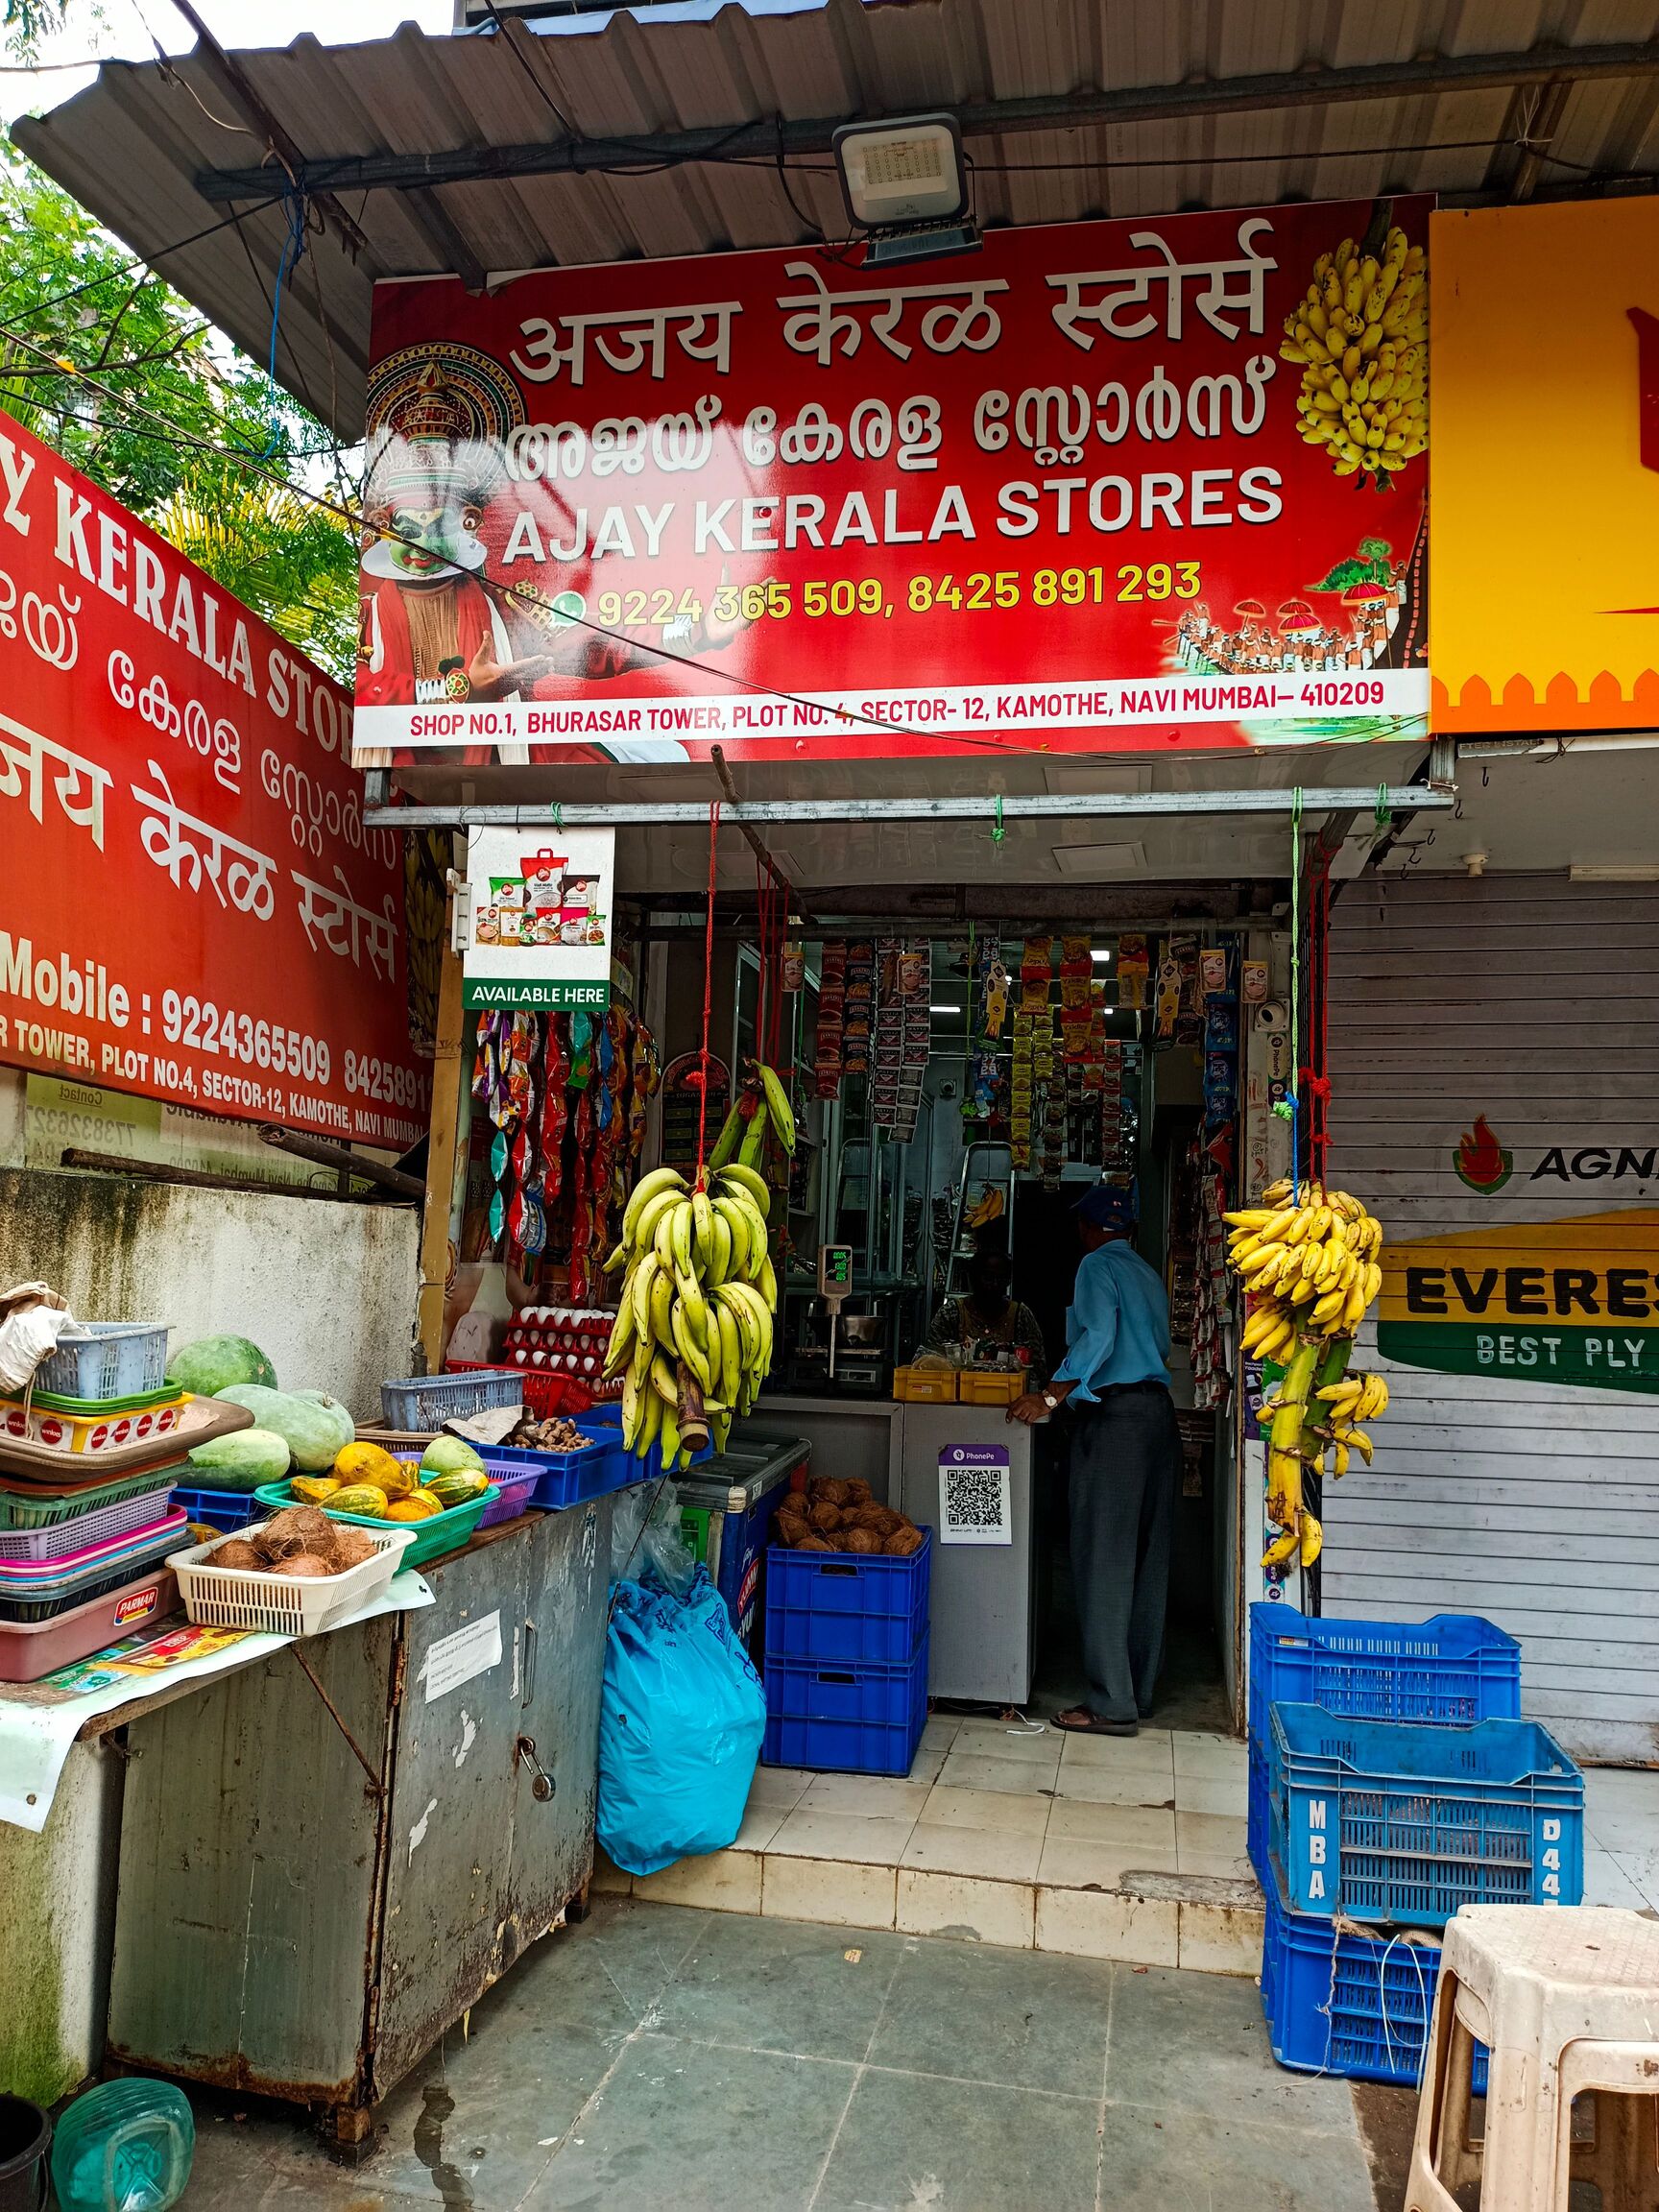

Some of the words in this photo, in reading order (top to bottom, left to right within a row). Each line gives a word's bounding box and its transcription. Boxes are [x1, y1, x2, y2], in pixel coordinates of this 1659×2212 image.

[510, 301, 743, 386] अजय
[776, 261, 1009, 366] केरळ
[1046, 218, 1278, 350] स्टोर्स
[506, 395, 722, 482] അജയ്
[742, 395, 943, 470] കേരള
[502, 502, 675, 565] AJAY
[695, 485, 976, 555] KERALA
[996, 466, 1284, 538] STORES
[54, 476, 257, 699] KERALA
[598, 588, 703, 627] 9224
[714, 583, 792, 622] 365
[804, 578, 894, 620] 509,
[908, 571, 1021, 612] 8425
[1032, 566, 1104, 606] 891
[1117, 562, 1201, 602] 293
[108, 650, 241, 795] കേരള
[410, 714, 466, 737] SHOP
[527, 709, 643, 733] BHURASAR
[647, 706, 728, 733] TOWER,
[733, 704, 787, 728] PLOT
[792, 703, 829, 726] NO.
[861, 697, 956, 722] SECTOR-
[962, 697, 990, 722] 12,
[997, 690, 1113, 719] KAMOTHE,
[1120, 688, 1177, 713] NAVI
[1301, 681, 1384, 707] 410209
[131, 759, 278, 922] केरळ
[290, 865, 399, 983] स्टोर्स
[0, 930, 131, 1028] Mobile
[161, 989, 331, 1086] 9224365509
[471, 986, 561, 1003] AVAILABLE
[565, 988, 605, 1003] HERE
[14, 1019, 95, 1076] TOWER,
[102, 1043, 149, 1082] PLOT
[154, 1056, 198, 1100] NO.4,
[202, 1074, 286, 1119] SECTOR-12,
[289, 1093, 352, 1135] KAMOTHE,
[355, 1109, 381, 1136] NAVI
[1530, 1147, 1659, 1183] AGN
[1407, 1266, 1659, 1318] EVERE
[1477, 1335, 1561, 1365] BEST
[1585, 1338, 1646, 1367] PLY
[966, 1452, 995, 1460] PhonePe
[119, 1591, 156, 1615] PARMAR
[1309, 1799, 1326, 1900] MBA
[1542, 1818, 1562, 1906] D44
